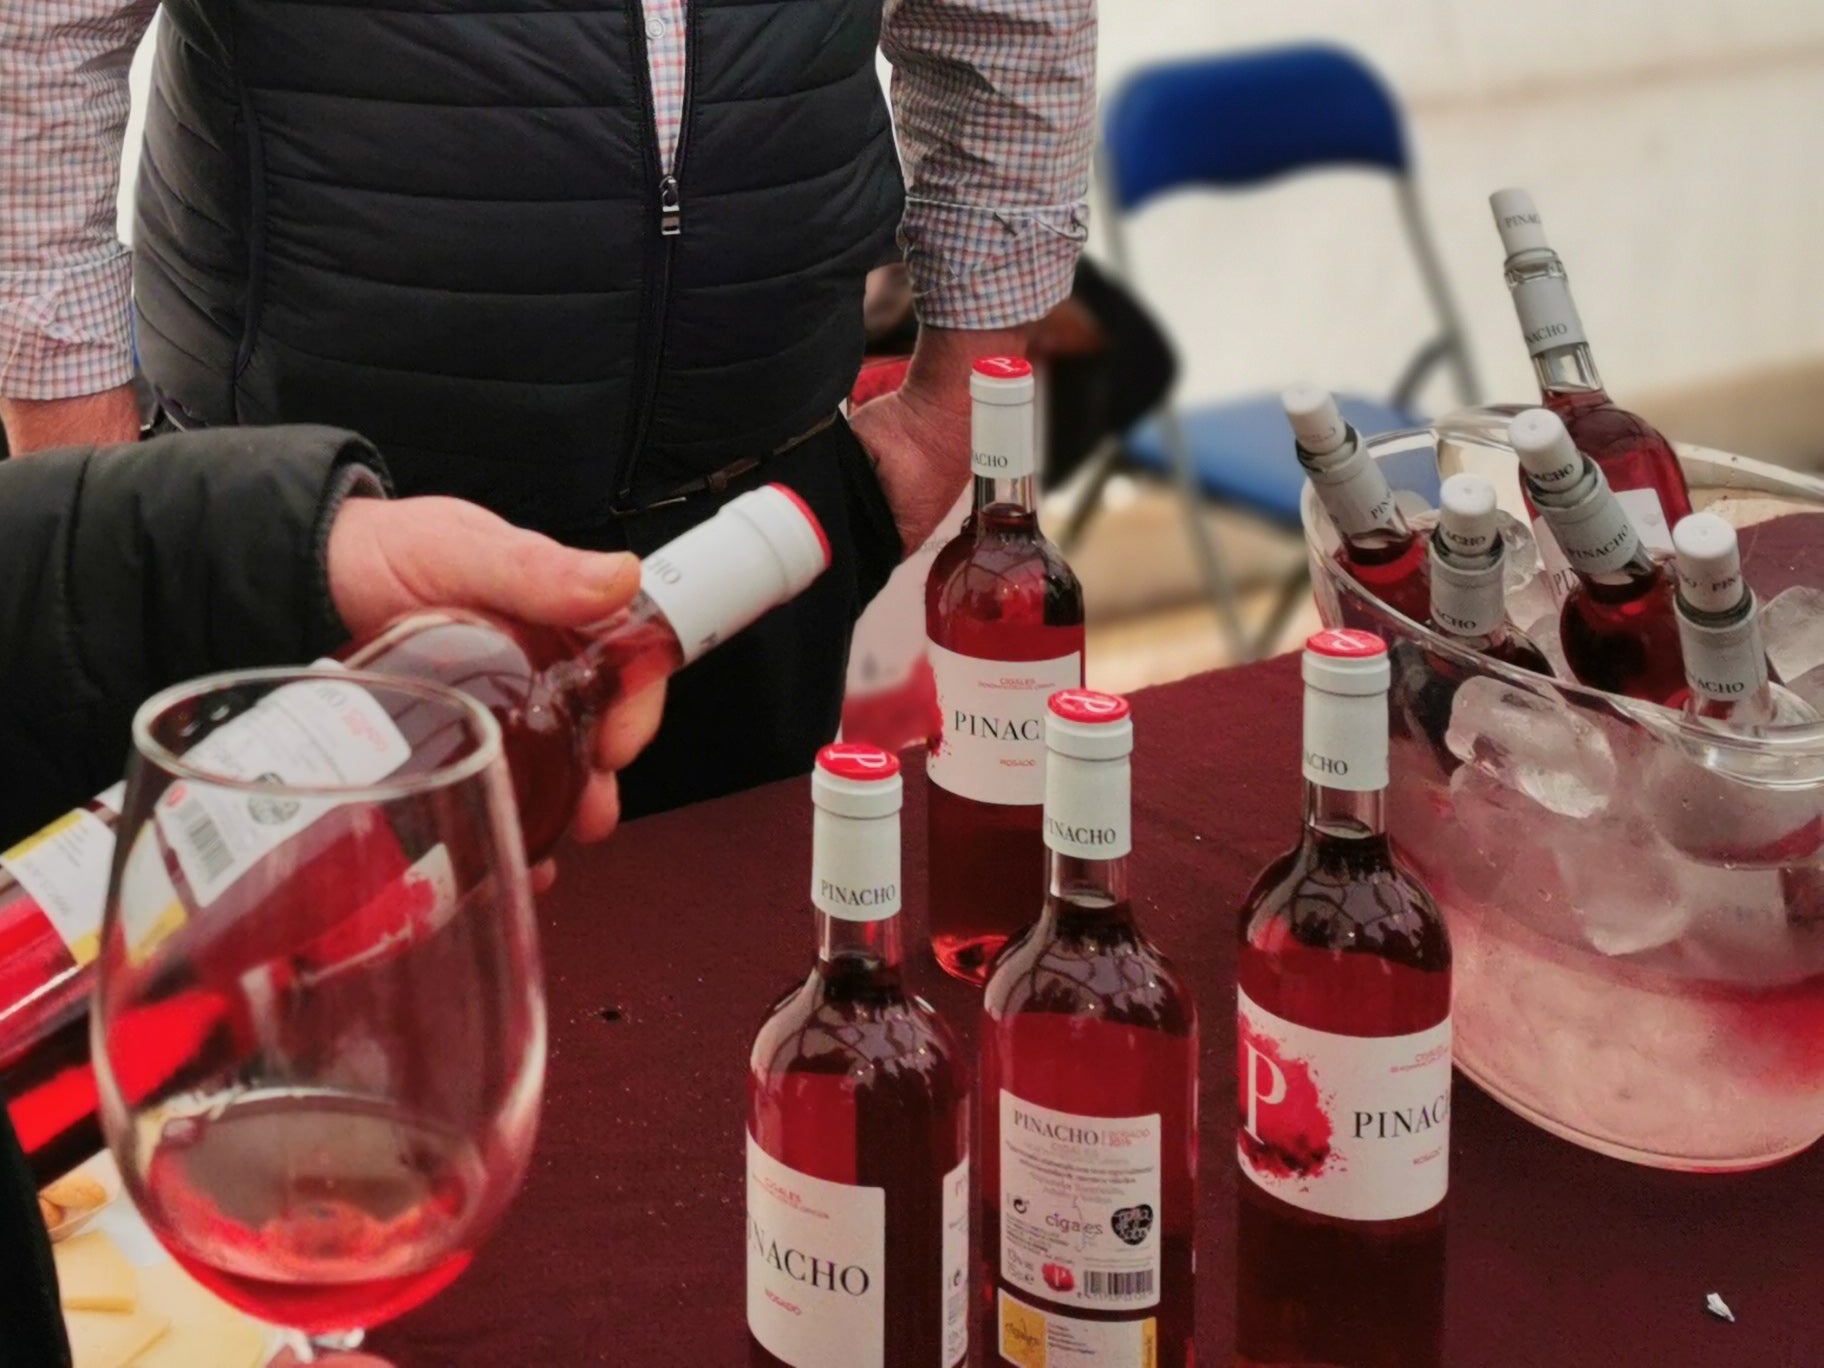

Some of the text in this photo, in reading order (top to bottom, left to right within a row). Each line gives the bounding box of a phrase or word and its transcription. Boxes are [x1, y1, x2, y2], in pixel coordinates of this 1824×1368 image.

[827, 749, 888, 769] P
[820, 879, 896, 907] PINACHO
[1243, 1039, 1288, 1145] P
[1013, 1109, 1099, 1146] PINACHO
